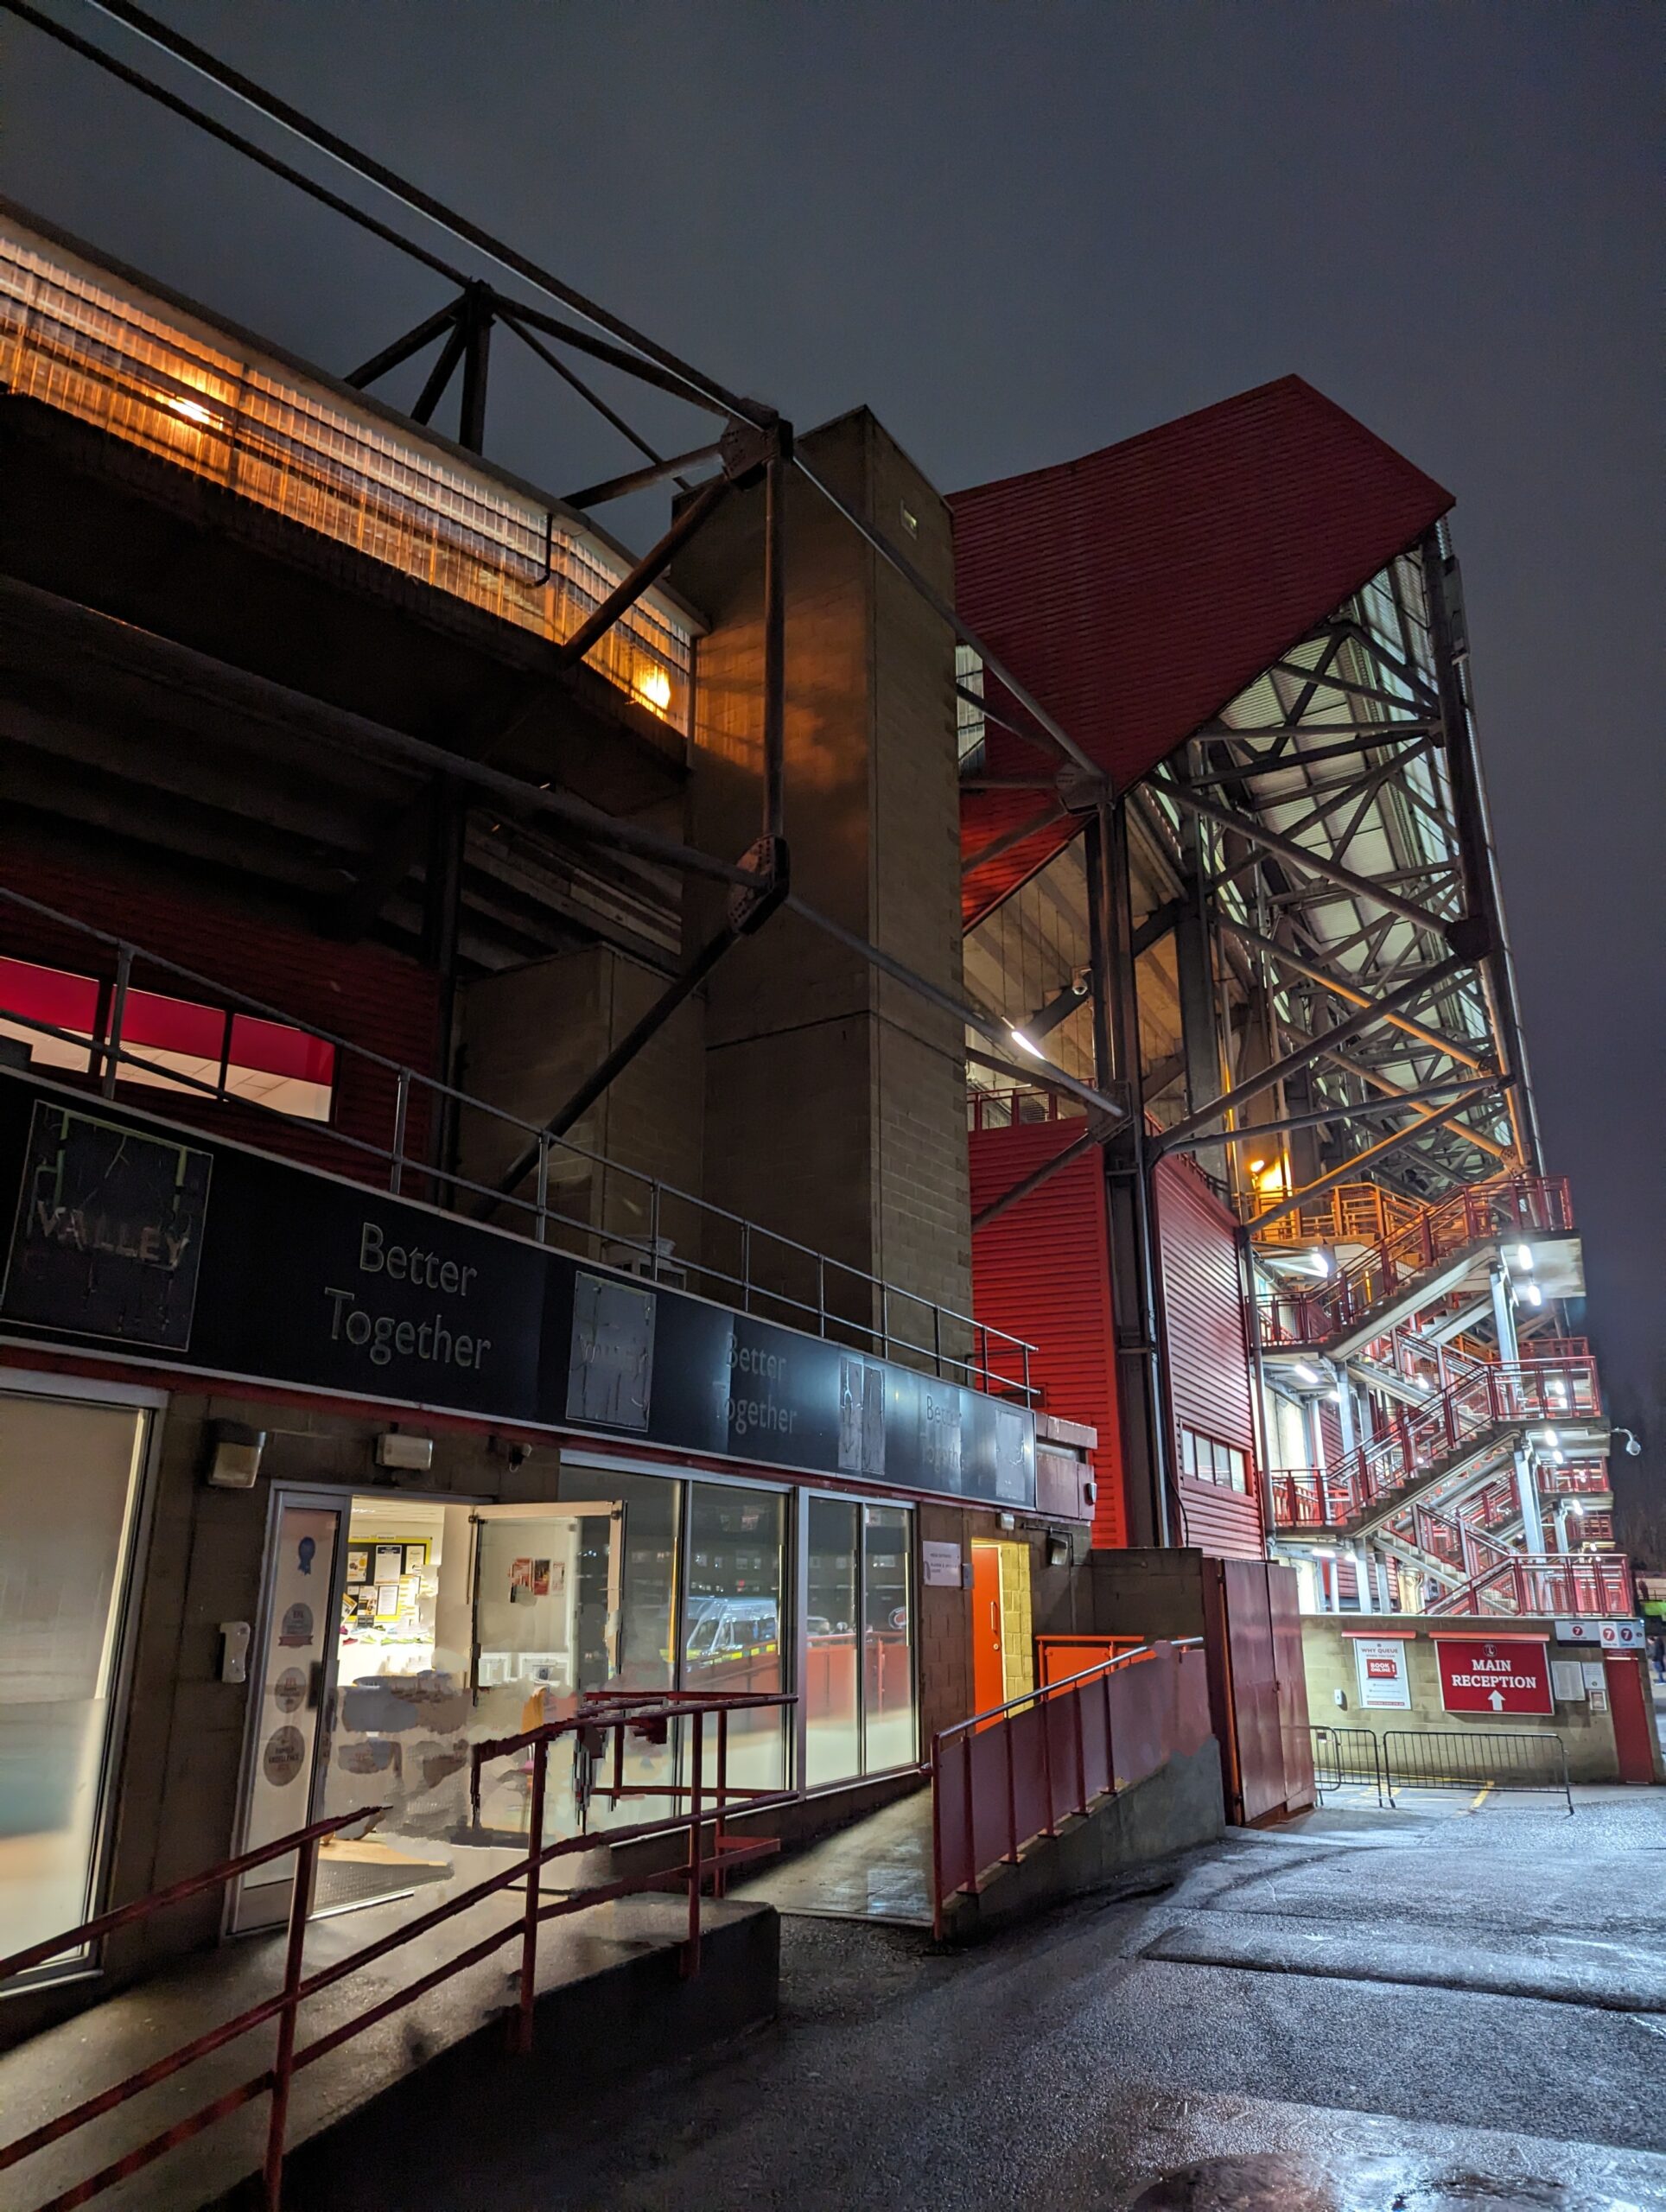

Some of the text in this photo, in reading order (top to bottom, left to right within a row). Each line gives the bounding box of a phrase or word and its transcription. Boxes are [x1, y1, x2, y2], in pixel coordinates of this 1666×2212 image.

[359, 1222, 478, 1296] Better
[324, 1287, 492, 1370] Together
[727, 1332, 787, 1382] Better
[1605, 1630, 1612, 1640] 7
[1623, 1630, 1631, 1640] 7
[1472, 1659, 1511, 1672] MAIN
[1451, 1675, 1537, 1688] RECEPTION
